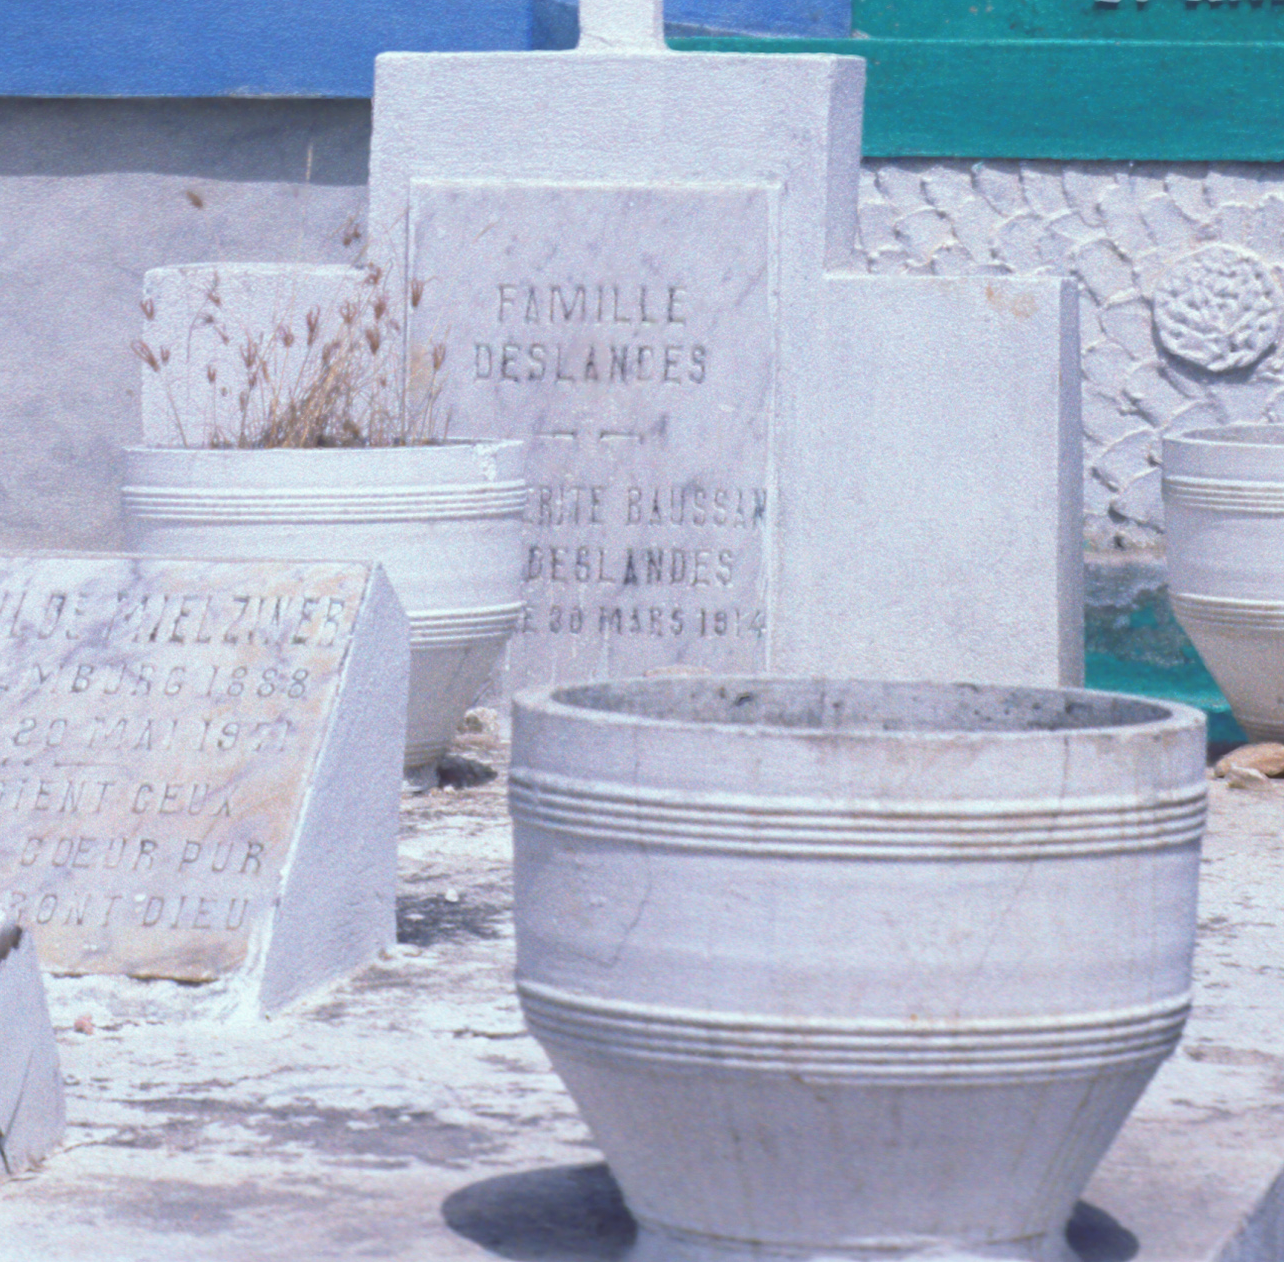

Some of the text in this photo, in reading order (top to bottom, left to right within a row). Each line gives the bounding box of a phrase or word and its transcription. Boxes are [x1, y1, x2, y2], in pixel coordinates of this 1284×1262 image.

[497, 284, 688, 326] FAMILLE
[474, 341, 707, 385] DESLANDES
[523, 545, 733, 588] DESLANDES
[598, 606, 684, 638] MARS
[205, 664, 309, 699] 1888
[12, 716, 68, 748] 20
[129, 780, 237, 818] CEUX
[177, 839, 265, 876] PUR
[142, 894, 249, 931] DIEU
